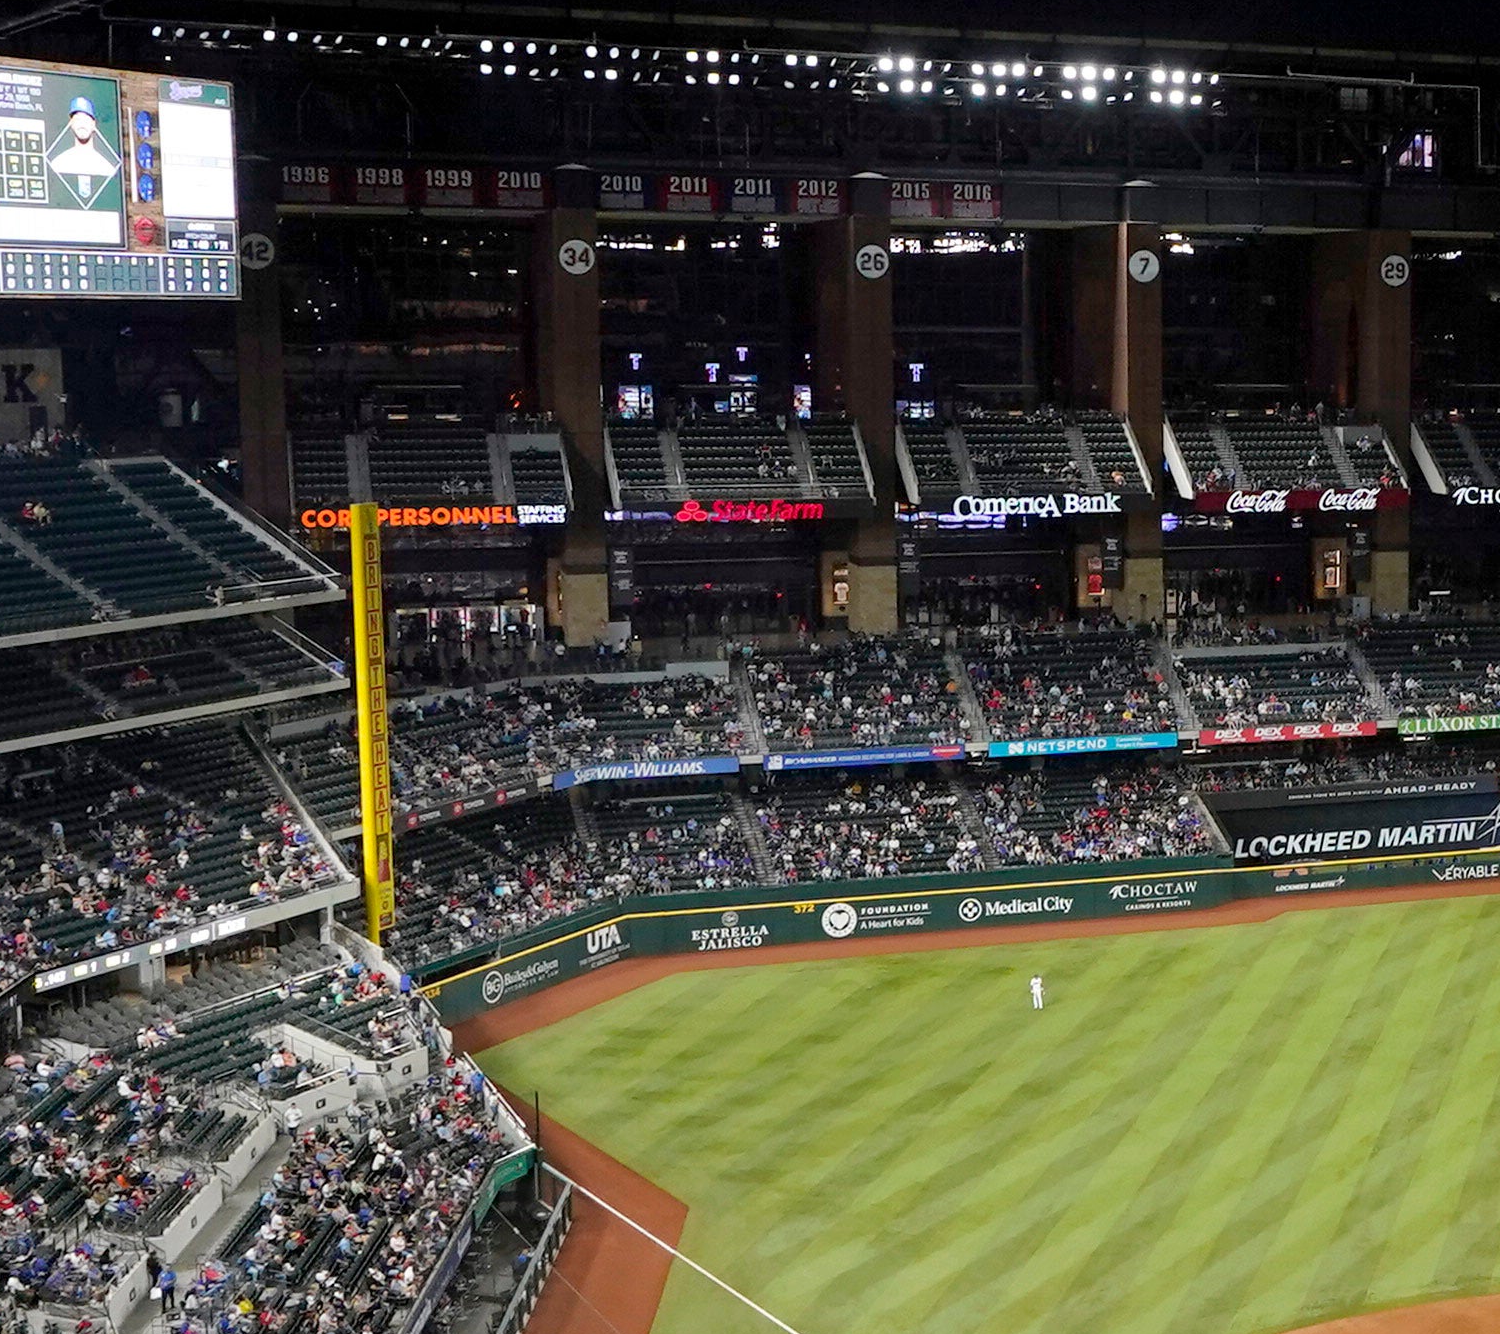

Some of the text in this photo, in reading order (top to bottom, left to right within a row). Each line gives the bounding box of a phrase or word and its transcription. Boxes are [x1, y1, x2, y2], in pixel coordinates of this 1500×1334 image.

[426, 169, 473, 187] 1999
[498, 171, 542, 189] 2010
[601, 174, 643, 192] 2010
[670, 175, 708, 194] 2011
[734, 178, 772, 196] 2011
[798, 179, 838, 197] 2012
[891, 182, 930, 199] 2015
[953, 183, 992, 201] 2016
[564, 247, 591, 267] 34
[859, 253, 885, 272] 26
[1138, 257, 1151, 277] 7
[1384, 260, 1406, 280] 29
[2, 365, 36, 403] K
[1064, 492, 1121, 515] Bank
[377, 504, 566, 527] PERSONNEL STAFFING
[519, 514, 566, 525] SERVICES
[365, 540, 390, 833] BRING THE HEAT
[1254, 727, 1283, 738] DEX
[1293, 724, 1322, 735] DEX
[1331, 722, 1361, 733] DEX
[1415, 717, 1476, 733] LUXOR
[1214, 729, 1243, 740] DEX
[1027, 738, 1107, 753] NETSPEND
[1384, 781, 1476, 795] AHEAD-READY
[1234, 821, 1477, 859] LOCKHEED MARTIN
[1432, 864, 1498, 882] VERYABLE
[1119, 881, 1198, 899] CHOCTAW
[1275, 880, 1336, 892] LOCKHEED MARTIN
[794, 903, 815, 913] 372
[861, 902, 929, 915] FOUNDATION
[985, 895, 1073, 916] Medical City
[1125, 898, 1191, 911] CASINOS RESORTS
[861, 916, 924, 929] A Heart for Kids
[586, 924, 623, 954] UTA
[691, 924, 770, 941] ESTRELLA
[697, 935, 763, 951] JALISCO
